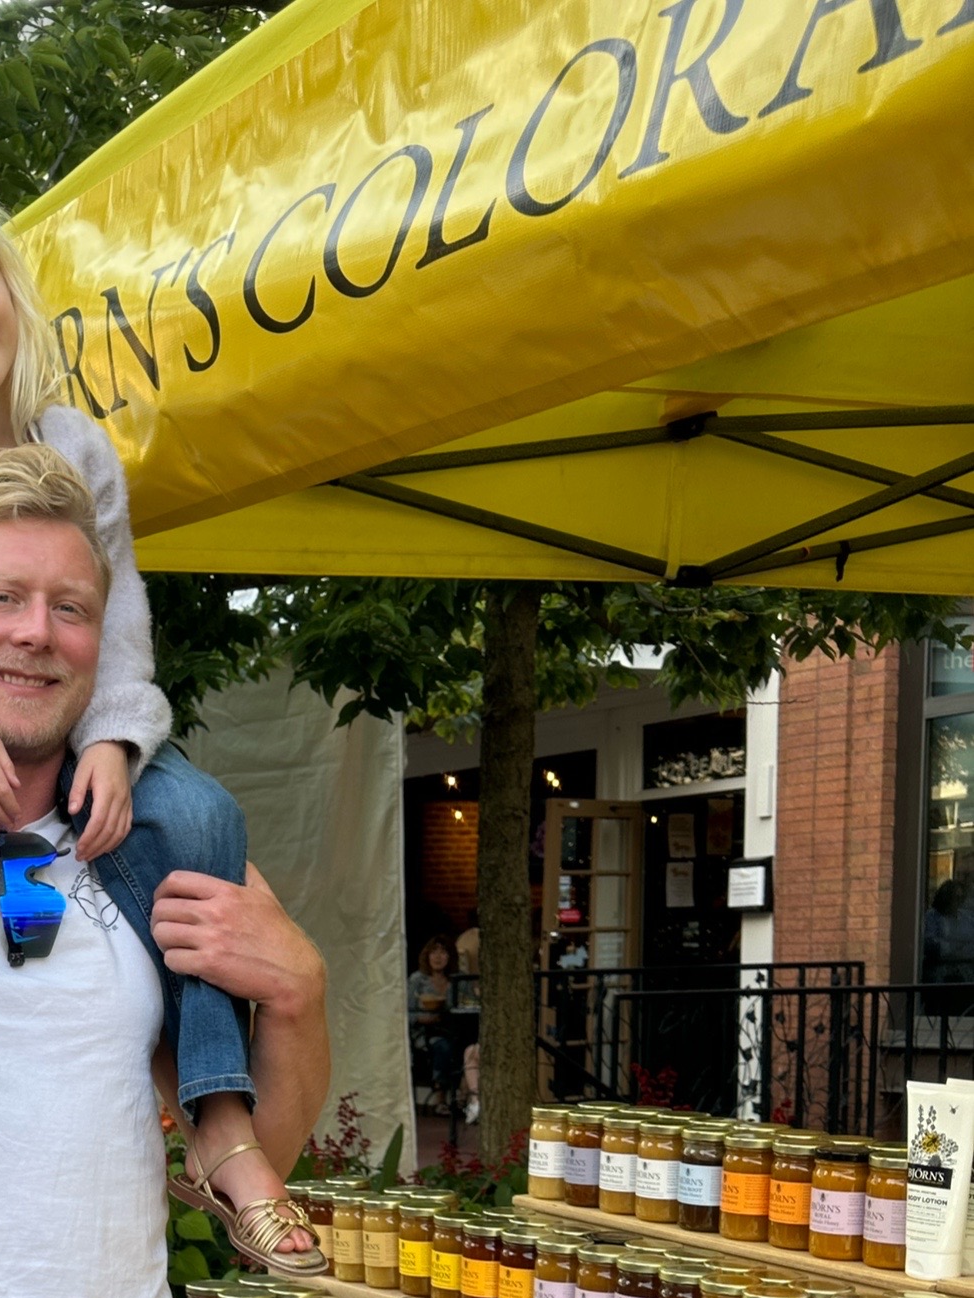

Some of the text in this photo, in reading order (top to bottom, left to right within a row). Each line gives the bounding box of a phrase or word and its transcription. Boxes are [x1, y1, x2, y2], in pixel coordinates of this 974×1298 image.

[50, 0, 974, 420] RN'S COLORA
[922, 1197, 948, 1206] LOTION
